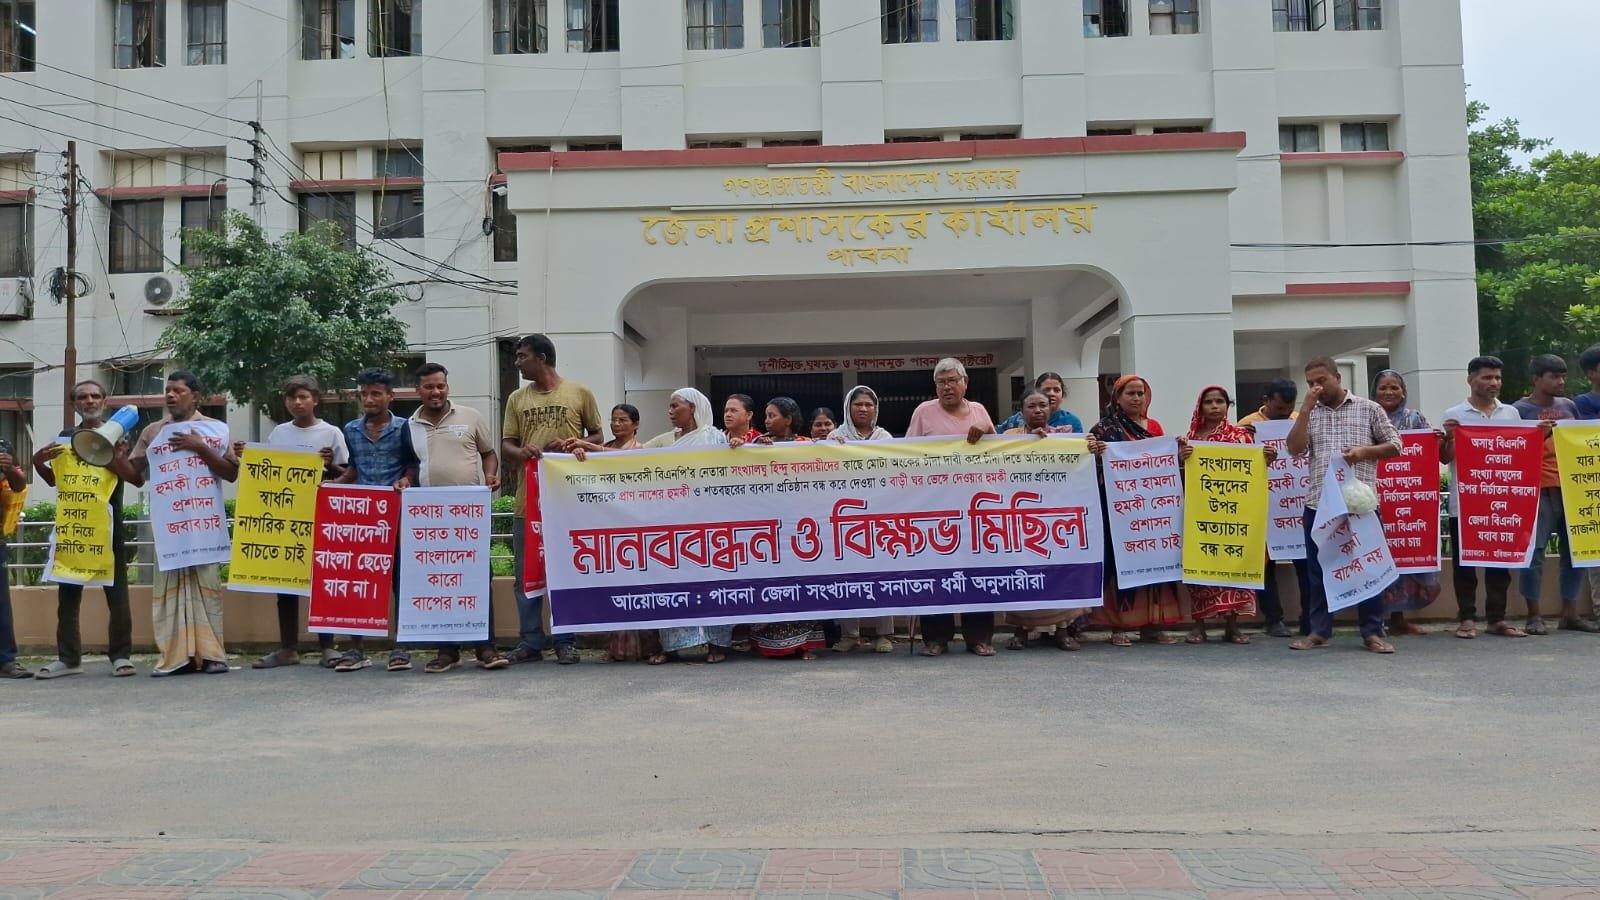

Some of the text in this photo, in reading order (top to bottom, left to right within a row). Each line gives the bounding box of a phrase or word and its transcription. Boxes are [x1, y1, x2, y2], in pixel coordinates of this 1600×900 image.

[723, 168, 1020, 197] গণপ্রজাতন্ত্রী বাংলাদেশ সরকার
[640, 201, 1098, 245] জেলা প্রশাসকের কার্যালয়
[827, 245, 912, 267] পাবনা
[1400, 443, 1424, 458] এনপি
[1471, 436, 1527, 452] অসাধু বিএনপি
[159, 459, 181, 474] ঘরে
[565, 473, 597, 485] পাবনার
[699, 466, 728, 478] নেতারা
[730, 463, 768, 478] সংখ্যালঘু
[770, 460, 788, 476] হিন্দু
[791, 458, 840, 474] ব্যবসায়ীদের
[842, 459, 863, 471] কাছে
[867, 456, 888, 470] মোটা
[943, 452, 962, 466] দাবী
[965, 454, 981, 465] করে
[1002, 451, 1021, 465] দিতে
[1058, 453, 1081, 464] করলে
[1109, 453, 1176, 472] সনাতনীদের
[1199, 456, 1253, 476] সংখ্যালঘু
[1385, 461, 1411, 473] নেতারা
[1485, 454, 1513, 466] নেতারা
[1576, 455, 1595, 467] যার
[247, 459, 319, 485] স্বাধীন দেশে
[1470, 469, 1493, 482] সংখ্যা
[155, 473, 191, 496] হুমকী
[577, 492, 616, 504] তাদেরকে
[619, 490, 635, 502] প্রাণ
[639, 489, 664, 500] নাশের
[666, 484, 690, 500] হুমকী
[694, 488, 701, 497] ও
[704, 484, 746, 497] শতবছরের
[749, 483, 774, 495] ব্যবসা
[776, 477, 811, 494] প্রতিষ্ঠান
[812, 480, 826, 491] বন্ধ
[829, 479, 847, 490] করে
[850, 477, 876, 490] দেওয়া
[879, 478, 886, 488] ও
[889, 472, 909, 489] বাড়ী
[911, 475, 924, 487] ঘর
[952, 472, 983, 485] দেওয়ার
[985, 469, 1007, 485] হুমকী
[1035, 469, 1067, 483] প্রতিবাদে
[1114, 473, 1177, 493] ঘরে হামলা
[1200, 474, 1250, 496] হিন্দুদের
[1458, 483, 1478, 496] উপর
[1511, 486, 1537, 497] করলো
[172, 496, 215, 513] প্রশাসন
[1113, 493, 1181, 516] হুমকী কেন?
[1413, 491, 1438, 502] করলো
[328, 495, 388, 516] আমরা ও
[408, 502, 485, 520] কথায় কথায়
[1208, 496, 1239, 515] উপর
[1395, 507, 1412, 518] কেন
[1491, 501, 1508, 513] কেন
[1578, 504, 1595, 518] ধর্ম
[63, 508, 89, 521] সবার
[1469, 514, 1523, 528] জেলা বিএনপি
[73, 523, 95, 538] নিয়ে
[166, 515, 222, 536] জবাব চাই
[239, 512, 314, 539] নাগরিক হয়ে
[321, 520, 393, 545] বাংলাদেশী
[568, 490, 1089, 574] মানববন্ধন ও বিক্ষভ মিছিল
[1129, 516, 1172, 533] প্রশাসন
[1196, 520, 1250, 538] অত্যাচার
[1397, 519, 1427, 533] বিএনপি
[412, 525, 480, 542] ভারত যাও
[1408, 536, 1421, 548] চায়
[1478, 531, 1515, 544] যবাব চায়
[89, 544, 105, 557] নয়
[1123, 533, 1182, 554] জবাব চাই
[1200, 542, 1245, 559] বন্ধ কর
[241, 541, 281, 561] বাচতে
[284, 542, 308, 566] চাই
[314, 549, 393, 575] বাংলা ছেড়ে
[414, 549, 477, 566] বাংলাদেশ
[323, 578, 351, 599] যাব
[353, 580, 370, 600] না
[427, 573, 464, 588] কারো
[611, 568, 1046, 612] আয়োজনে : পাবনা জেলা সংখ্যালঘু সনাতন ধর্মী অনুসারীরা
[412, 595, 478, 612] বাপের নয়
